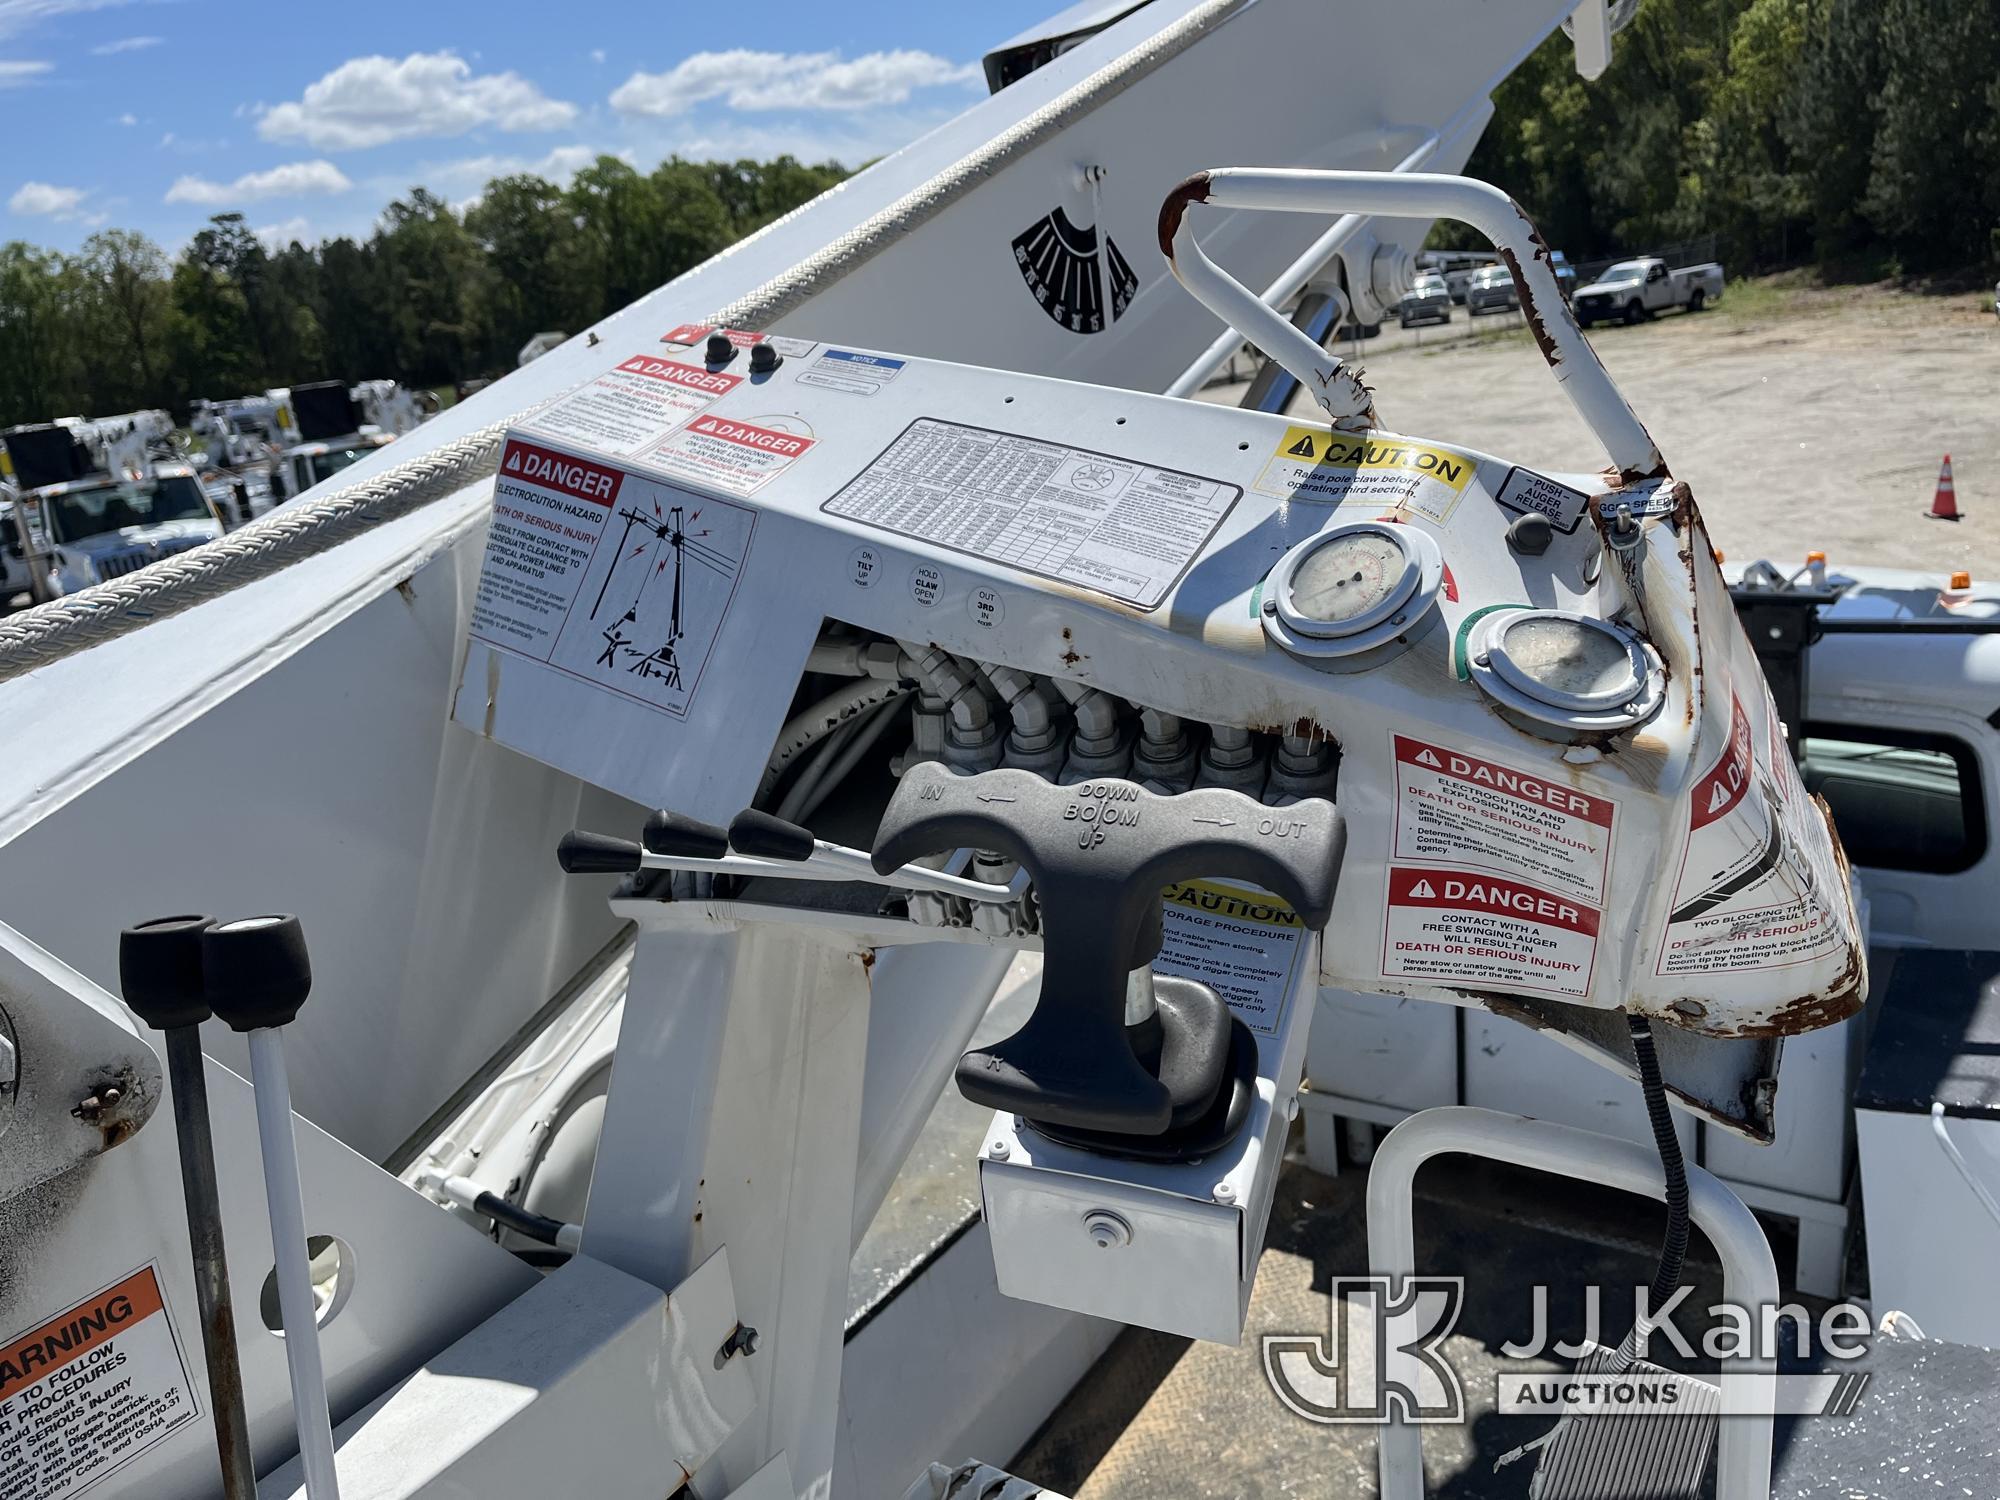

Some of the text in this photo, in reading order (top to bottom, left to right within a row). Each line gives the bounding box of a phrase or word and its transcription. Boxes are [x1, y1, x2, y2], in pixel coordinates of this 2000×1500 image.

[850, 354, 878, 366] NOTICE
[643, 362, 731, 392] DANGER
[690, 434, 776, 461] HOISTING PERSONNEL
[718, 425, 801, 453] DANGER
[685, 440, 768, 467] ON CRANE LOADLINE
[689, 448, 704, 457] CAN
[705, 451, 738, 466] RESULT
[523, 453, 614, 499] DANGER
[1293, 468, 1420, 487] Raise pole claw before
[1287, 480, 1417, 498] operating third section.
[1524, 488, 1562, 509] AUGER
[1534, 480, 1562, 497] PUSH
[497, 484, 603, 524] ELECTROCUTION HAZARD
[1515, 493, 1562, 520] RELEASE
[1633, 497, 1671, 509] SPEED
[511, 509, 598, 545] OR SERIOUS INJURY
[494, 522, 589, 560] RESULT FROM CONTACT WITH
[491, 555, 545, 579] AND APPARATUS
[519, 553, 566, 575] POWER LINES
[527, 544, 580, 569] CLEARANCE TO
[857, 561, 873, 571] TILT
[862, 551, 873, 560] DN
[858, 572, 869, 580] UP
[915, 579, 938, 591] CLAW
[918, 568, 938, 580] HOLD
[914, 587, 935, 599] OPEN
[979, 591, 995, 601] OUT
[977, 602, 994, 612] 3RD
[919, 784, 946, 801] IN
[1078, 783, 1139, 802] DOWN
[1450, 756, 1590, 816] DANGER
[1438, 777, 1566, 825] ELECTROCUTION AND
[1442, 787, 1562, 831] EXPLOSION HAZARD
[1063, 804, 1140, 827] BOOM
[1408, 786, 1597, 854] DEATH OR SERIOUS INJURY
[1078, 831, 1105, 849] UP
[1257, 819, 1307, 839] OUT
[1417, 827, 1586, 883] Determine their location before digging.
[1748, 879, 1768, 892] BOOM
[1444, 881, 1579, 924] DANGER
[1809, 905, 1819, 914] IN
[1441, 914, 1540, 936] CONTACT WITH A
[1694, 901, 1807, 928] TWO BLOCKING THE
[1214, 921, 1295, 941] PROCEDURE
[1422, 923, 1558, 949] FREE SWINGING AUGER
[1181, 932, 1266, 954] cable when storing.
[1185, 940, 1212, 951] result.
[1444, 935, 1533, 953] WILL RESULT IN
[1752, 943, 1777, 951] hook
[1780, 938, 1807, 948] block
[1396, 941, 1581, 973] DEATH OR SERIOUS INJURY
[1403, 958, 1429, 966] Never
[1464, 963, 1495, 971] unstow
[1497, 967, 1523, 975] auger
[1524, 970, 1544, 978] until
[1159, 956, 1268, 982] releasing digger control.
[1402, 966, 1437, 974] persons
[1454, 968, 1476, 976] clear
[1504, 974, 1526, 982] area.
[1222, 992, 1253, 1004] digger
[0, 1295, 134, 1390] ARNING
[20, 1342, 114, 1403] TO FOLLOW
[18, 1353, 127, 1424] PROCEDURES
[1, 1377, 133, 1461] OR SERIOUS INJURY
[36, 1391, 92, 1427] Result in
[32, 1394, 134, 1458] offer for use, use,
[43, 1393, 150, 1462] this Digger Derrick:
[43, 1387, 178, 1475] with the requirements of:
[41, 1396, 180, 1486] Standards Institute A10.31
[35, 1417, 166, 1500] Safety Code, and OSHA
